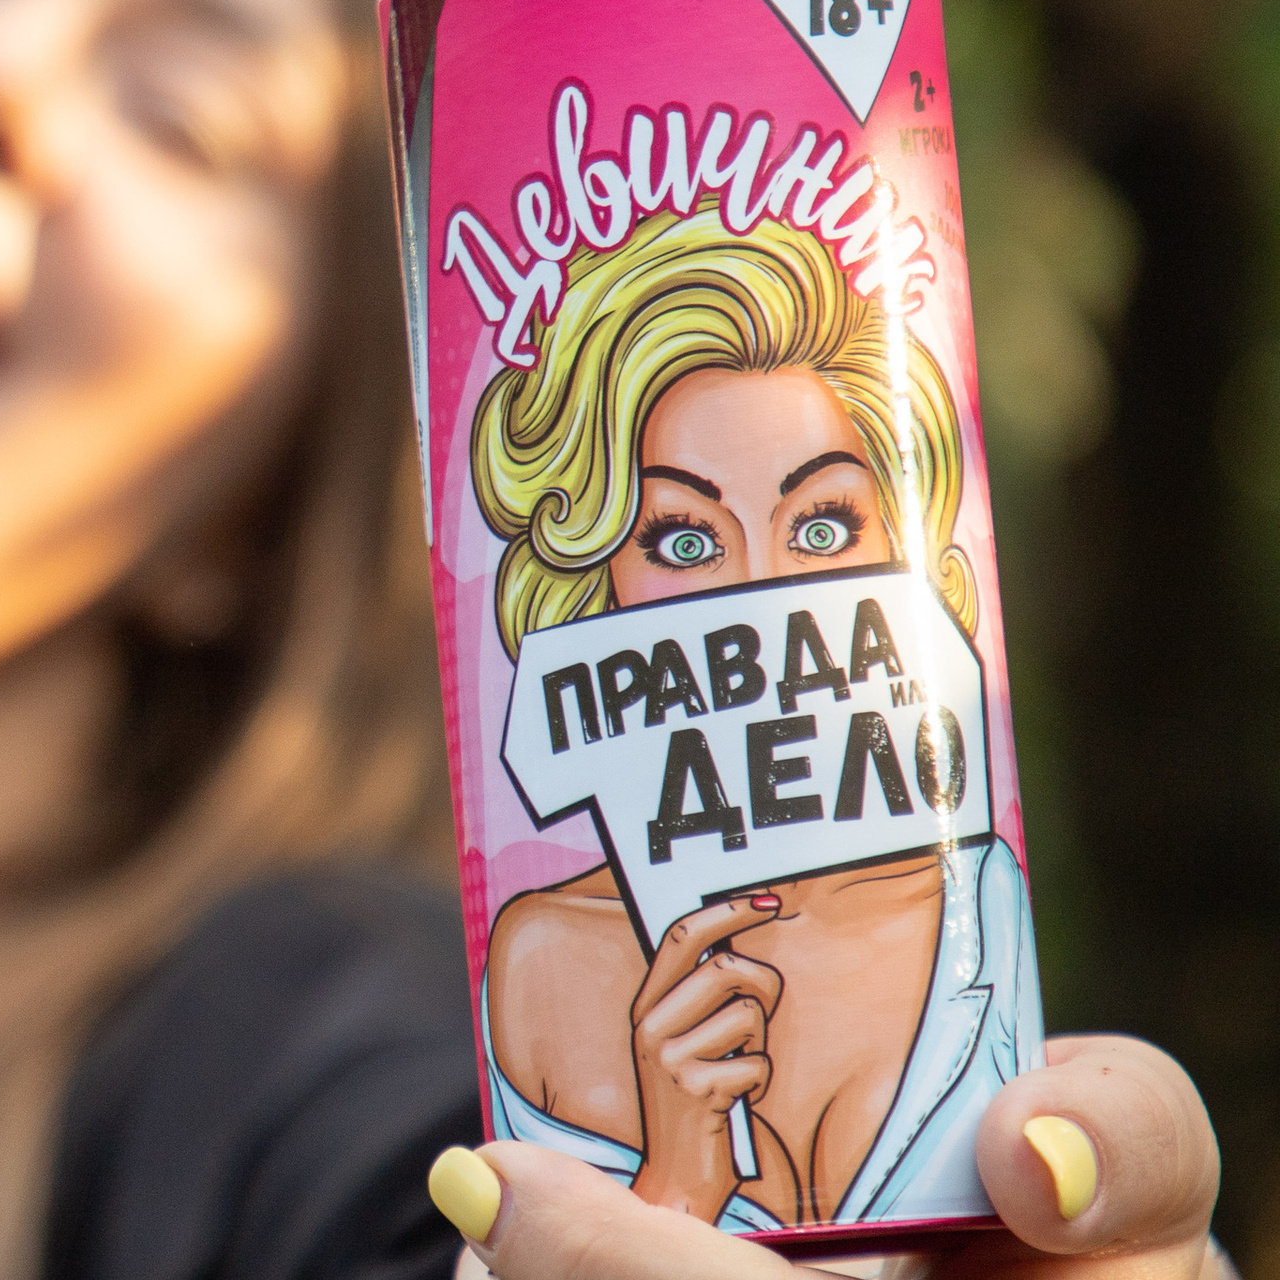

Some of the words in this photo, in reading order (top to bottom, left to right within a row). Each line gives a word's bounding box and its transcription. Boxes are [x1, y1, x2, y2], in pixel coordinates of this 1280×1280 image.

[908, 70, 936, 112] 2+
[542, 598, 903, 755] ПРАВДА
[889, 679, 928, 708] ИЛ
[647, 711, 967, 865] ДЕЛО
